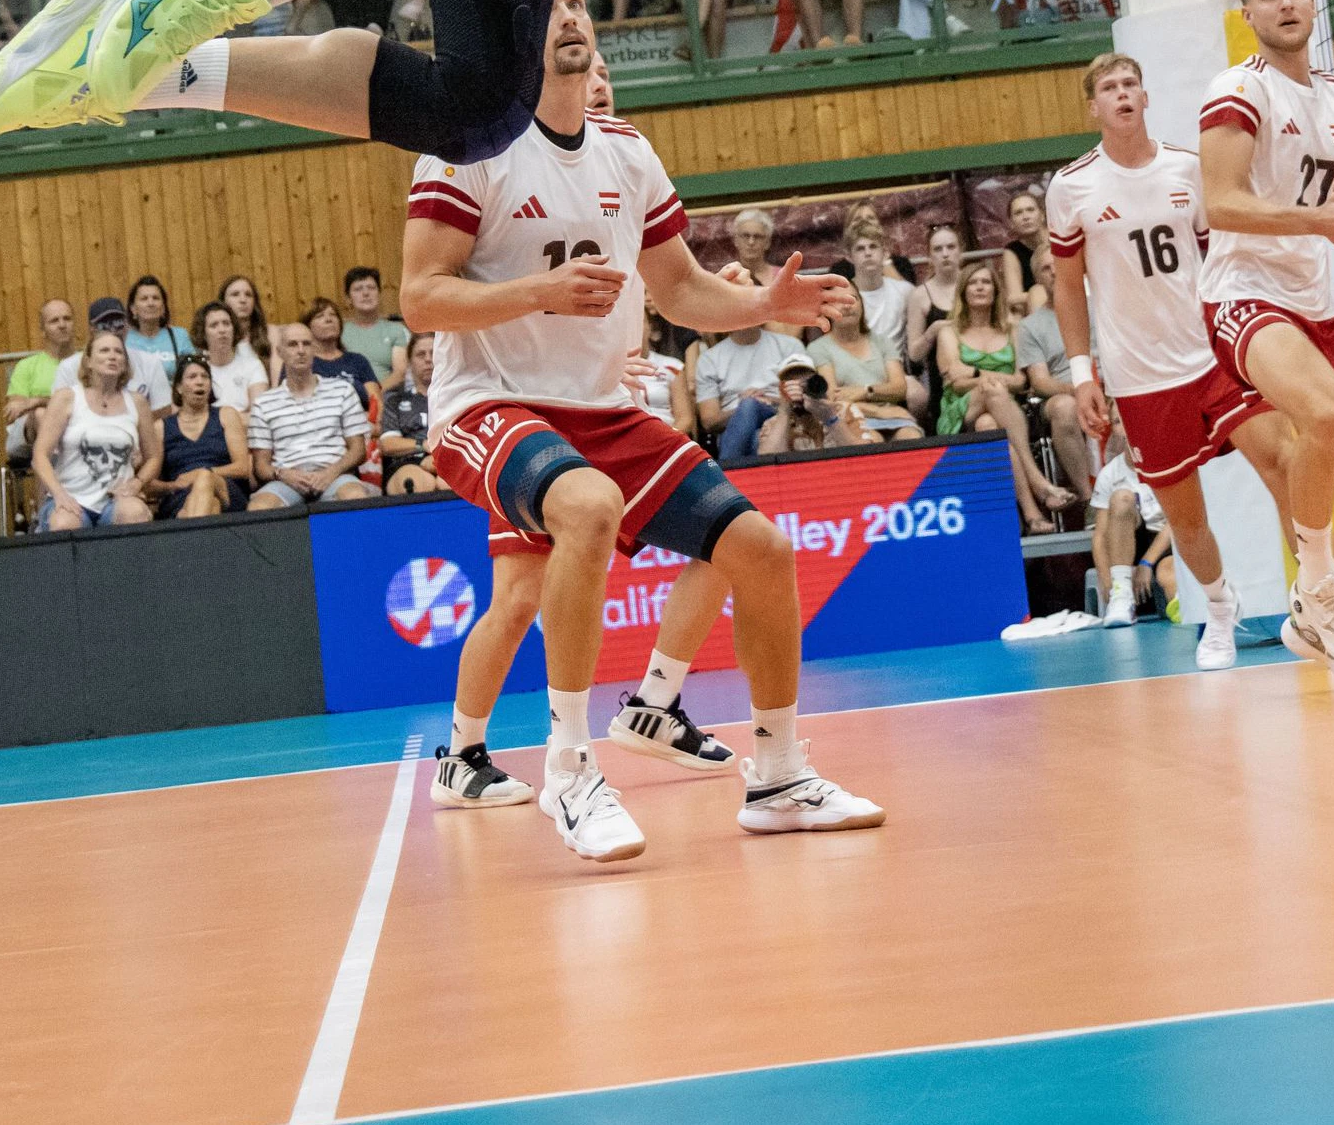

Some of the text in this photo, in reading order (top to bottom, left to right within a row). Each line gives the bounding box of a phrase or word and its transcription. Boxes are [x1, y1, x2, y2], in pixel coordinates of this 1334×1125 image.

[602, 208, 619, 218] AUT
[1128, 224, 1179, 279] 16
[478, 411, 505, 438] 12
[862, 496, 966, 544] 2026
